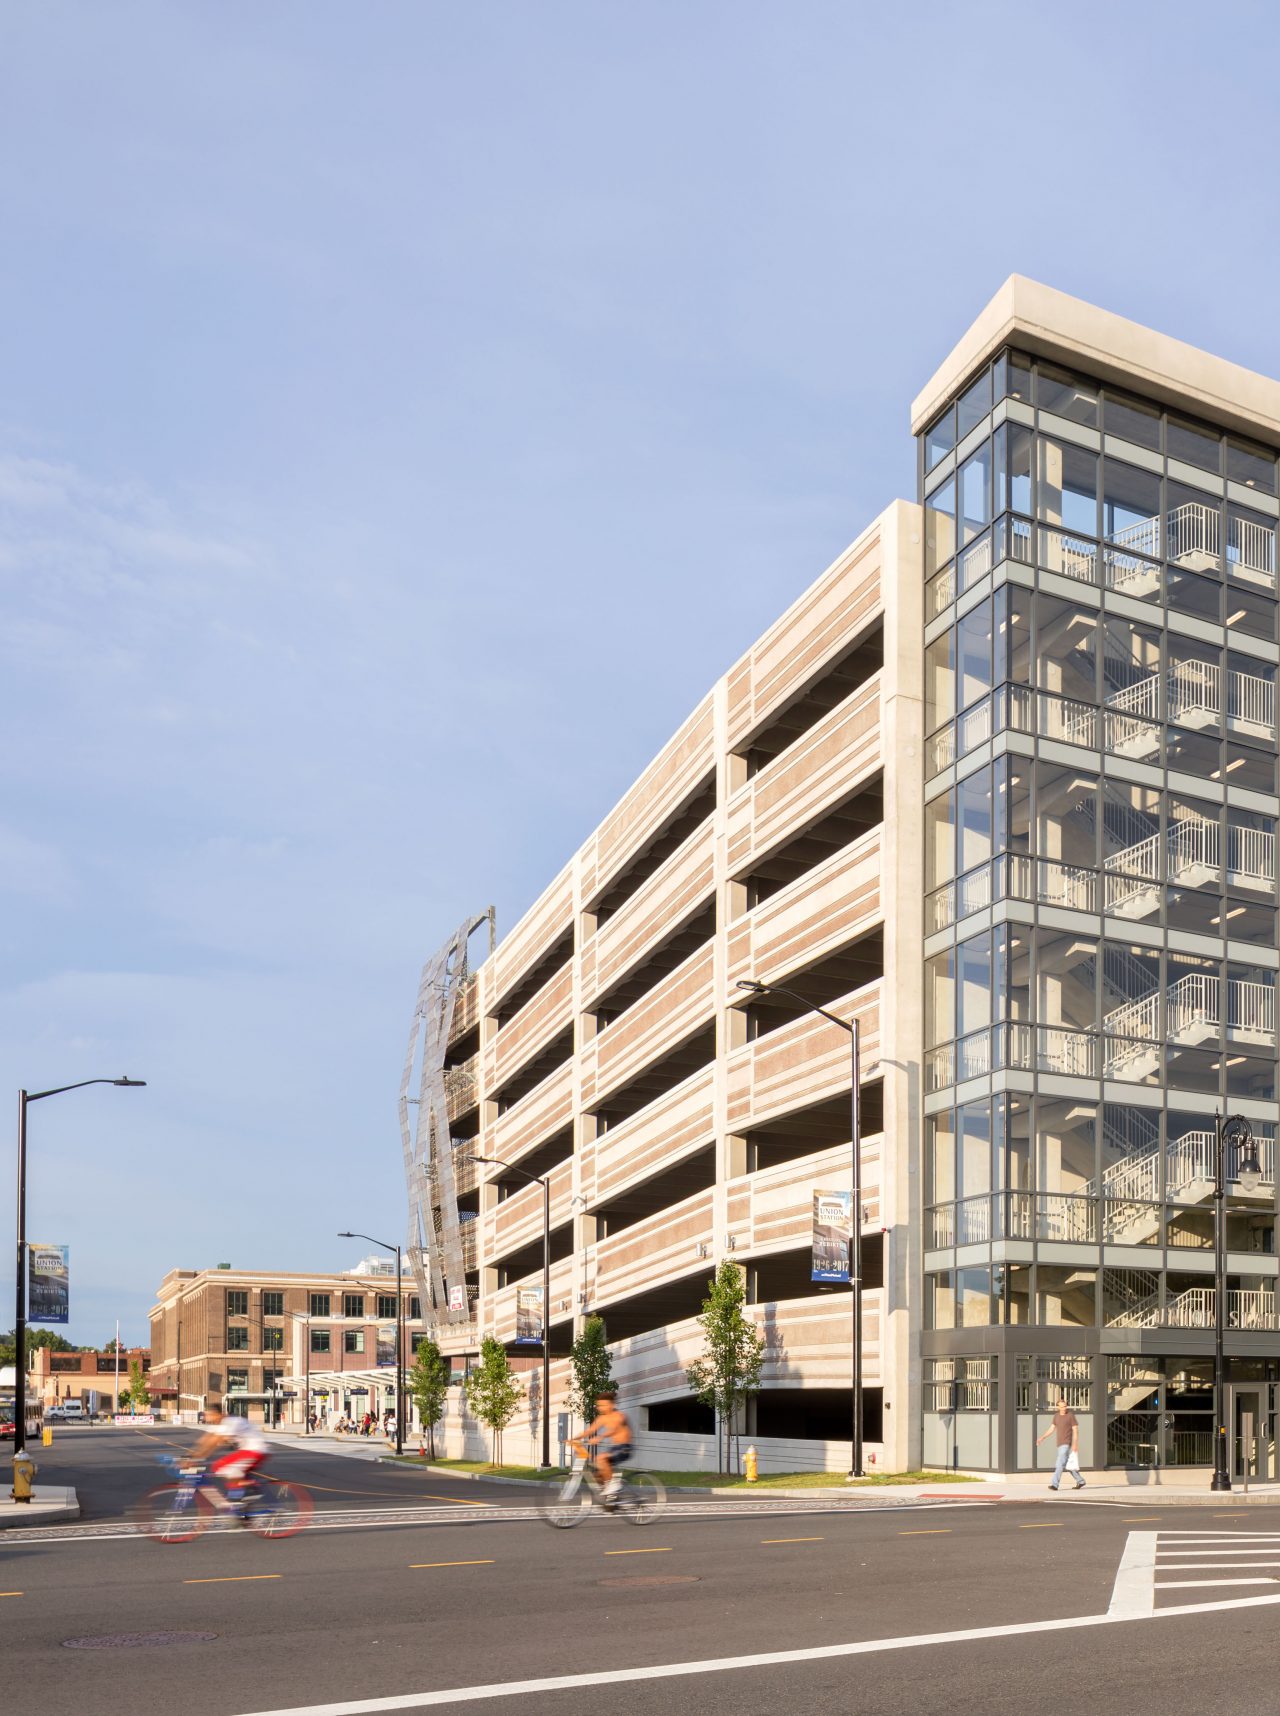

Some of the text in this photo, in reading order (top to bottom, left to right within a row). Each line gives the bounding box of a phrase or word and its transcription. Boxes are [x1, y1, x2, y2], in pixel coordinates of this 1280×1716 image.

[820, 1207, 843, 1215] UNION
[813, 1259, 849, 1272] 1926-2017
[1153, 1307, 1216, 1328] UNION
